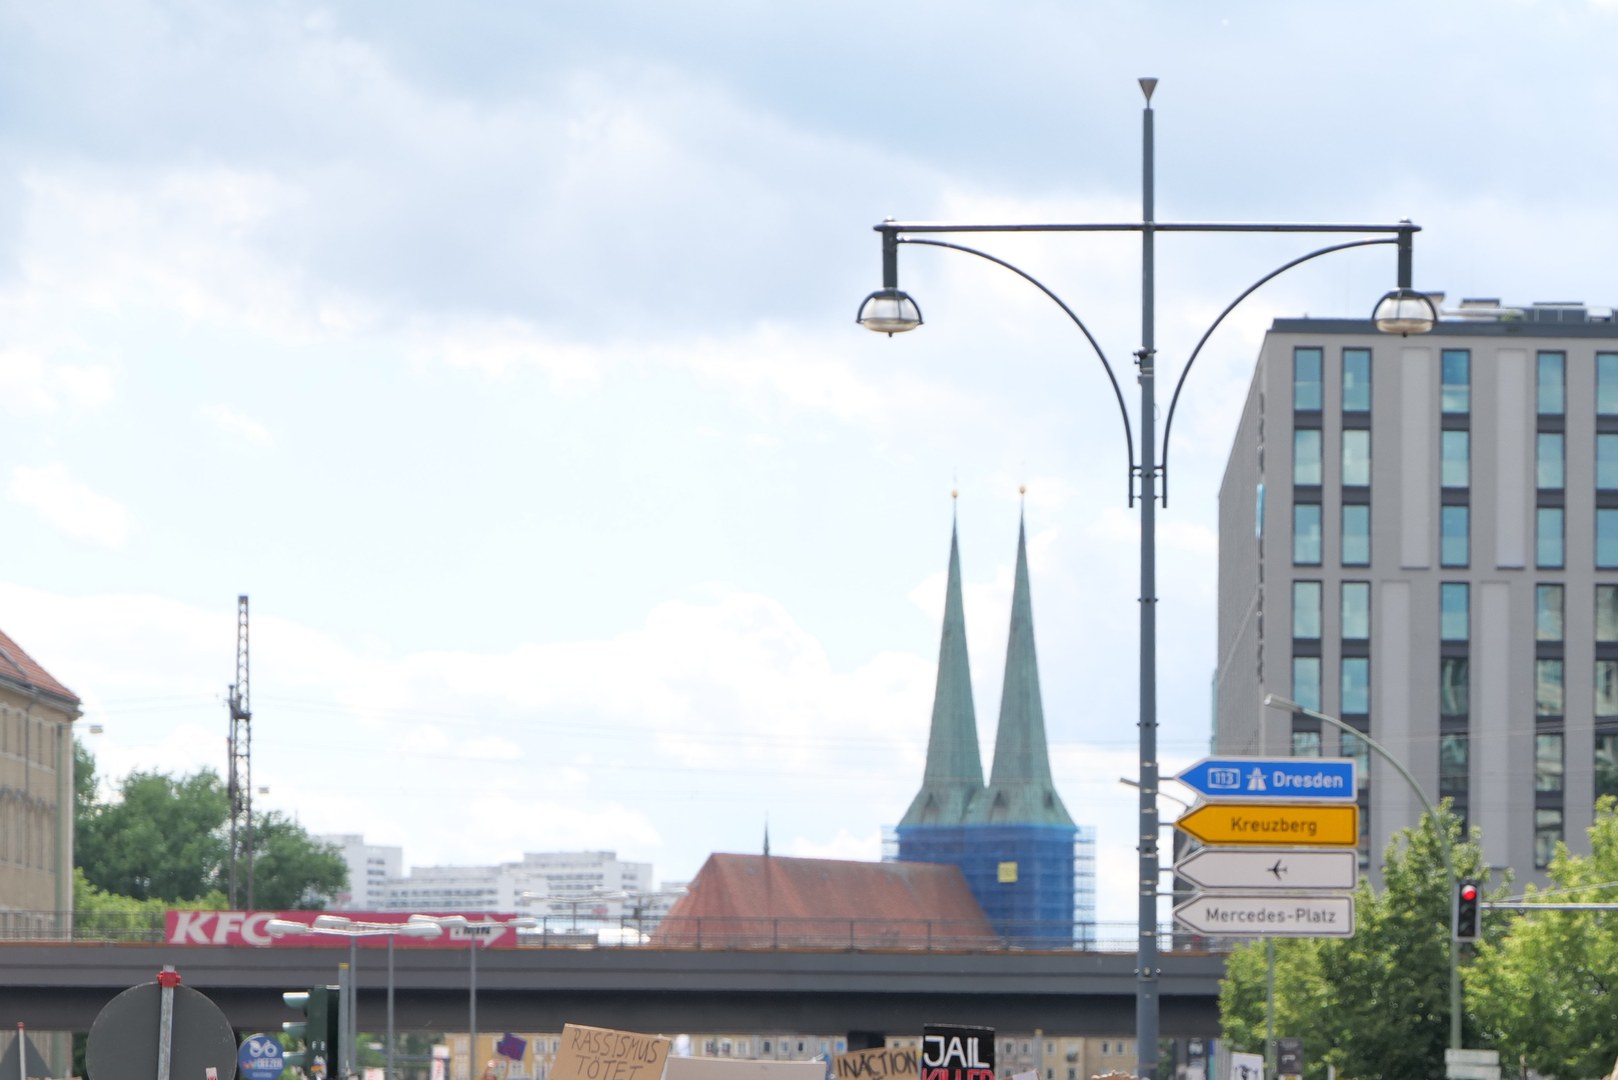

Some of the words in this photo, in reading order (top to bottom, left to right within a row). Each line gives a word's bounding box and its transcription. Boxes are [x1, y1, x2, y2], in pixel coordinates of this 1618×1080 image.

[1214, 772, 1234, 785] 113
[1272, 771, 1343, 788] Dresden
[1231, 816, 1318, 836] Kreuzberg
[169, 912, 276, 945] KFC
[1205, 907, 1336, 924] Mercedes-Platz
[571, 1028, 660, 1064] RASSISMUS
[924, 1036, 990, 1068] JAIL
[837, 1051, 919, 1079] INACTION
